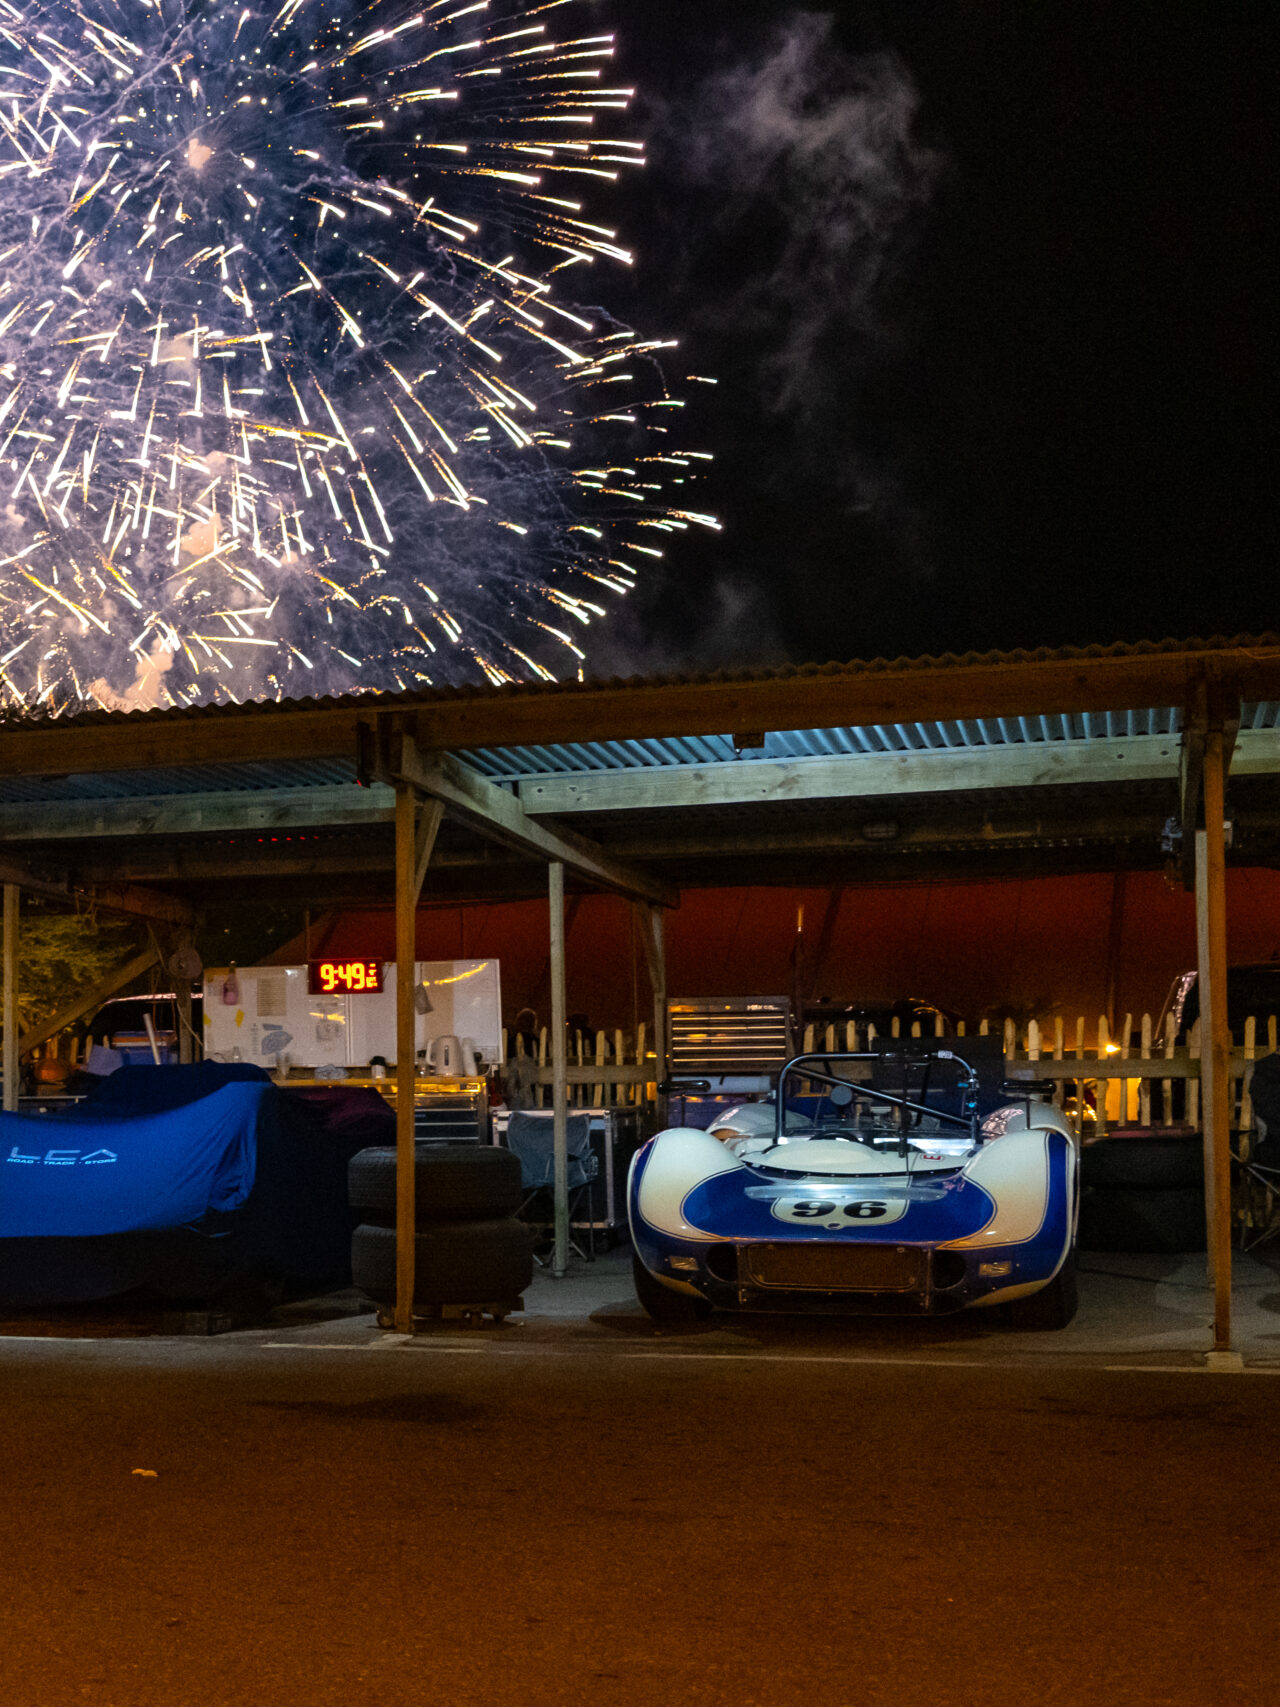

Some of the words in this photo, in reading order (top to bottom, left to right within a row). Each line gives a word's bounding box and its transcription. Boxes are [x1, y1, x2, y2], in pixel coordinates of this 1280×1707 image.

[320, 963, 365, 990] 9:49
[84, 1157, 118, 1165] STORE
[792, 1200, 887, 1218] 96
